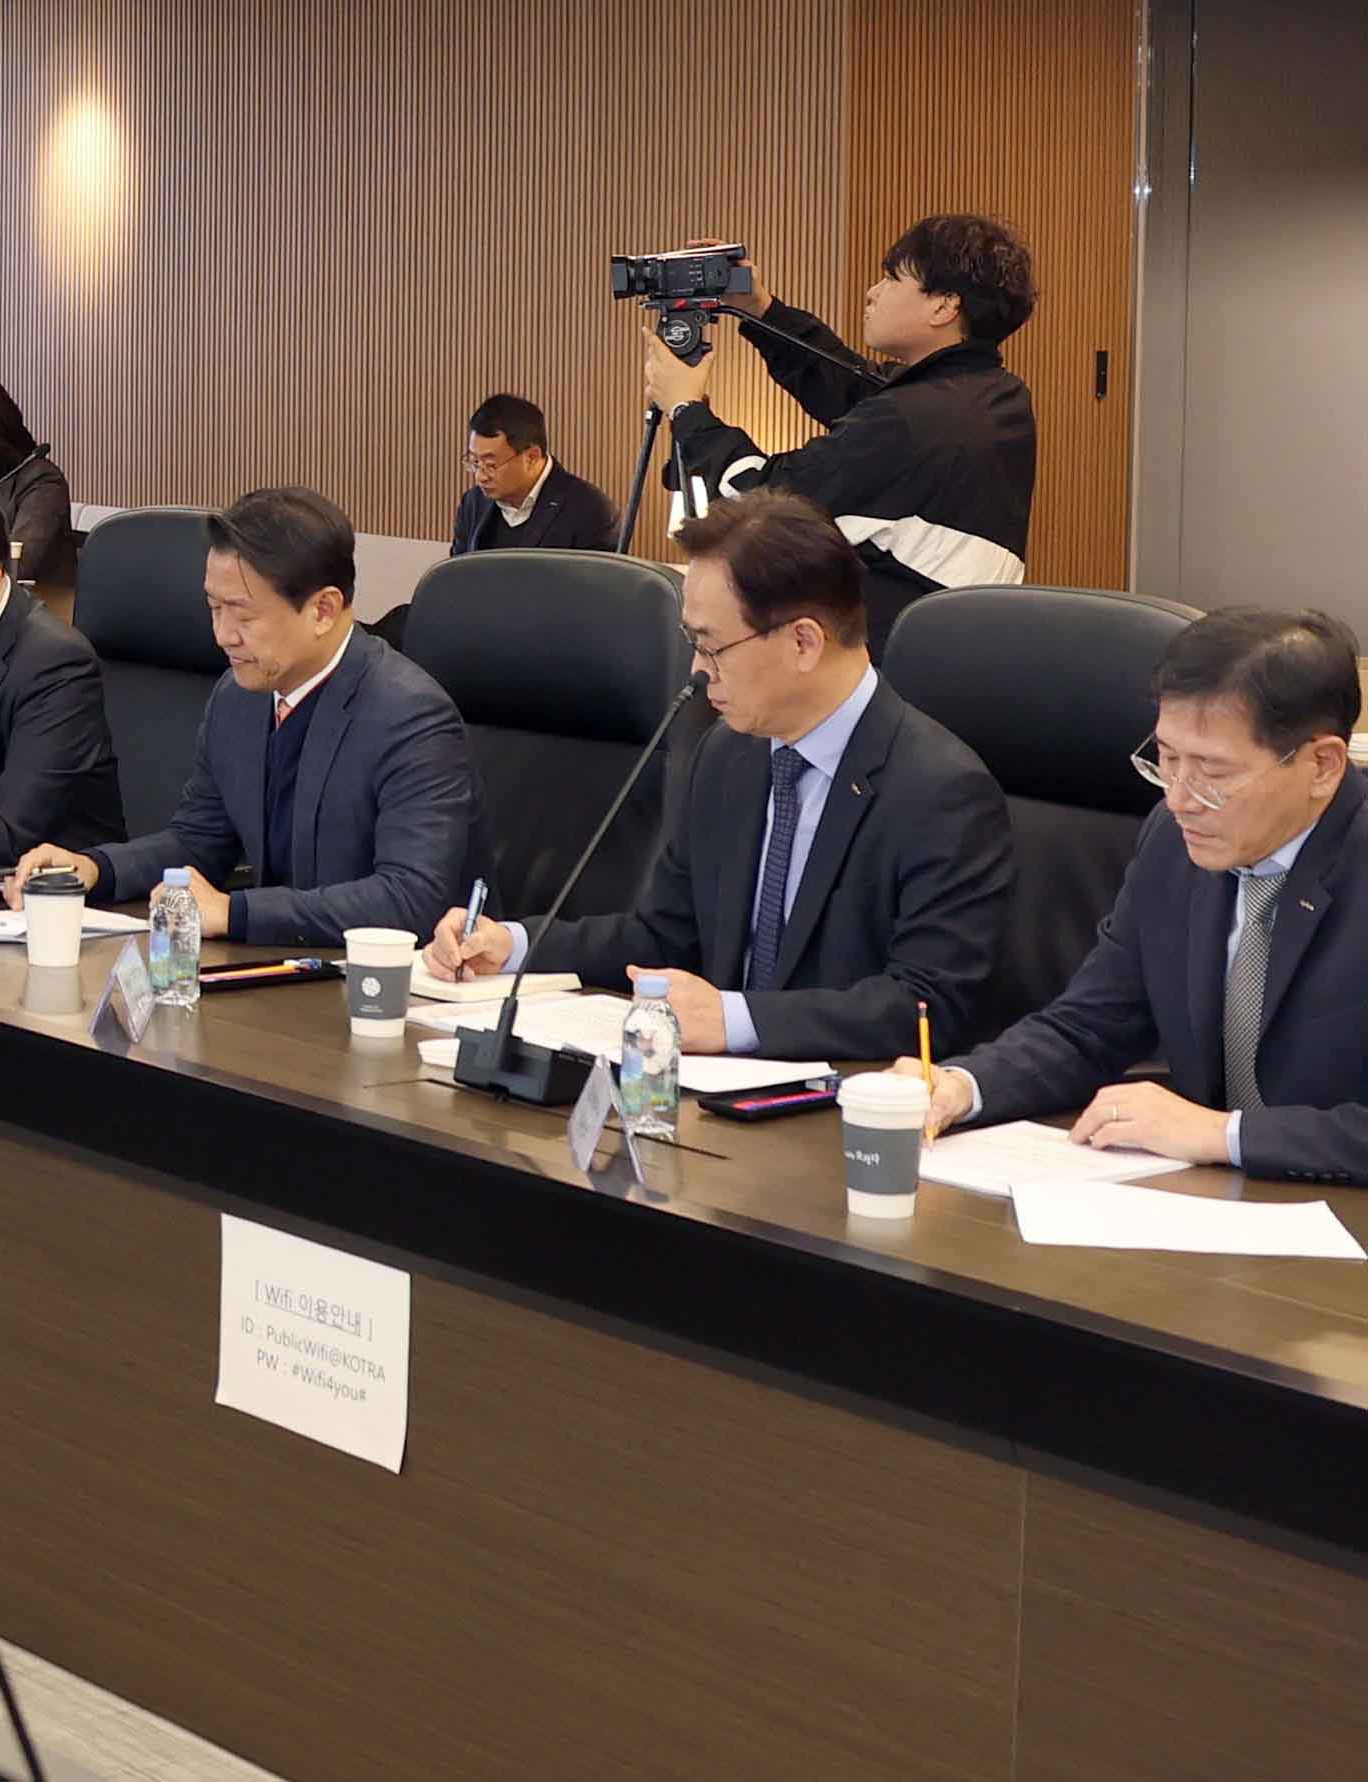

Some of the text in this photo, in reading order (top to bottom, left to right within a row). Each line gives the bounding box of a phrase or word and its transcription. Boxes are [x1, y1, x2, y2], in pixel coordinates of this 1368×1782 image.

[265, 1283, 292, 1308] Wifi
[298, 1293, 362, 1337] 이용안내
[241, 1315, 255, 1334] ID
[266, 1325, 386, 1383] PublicWifi@KOTRA
[256, 1348, 279, 1371] PW
